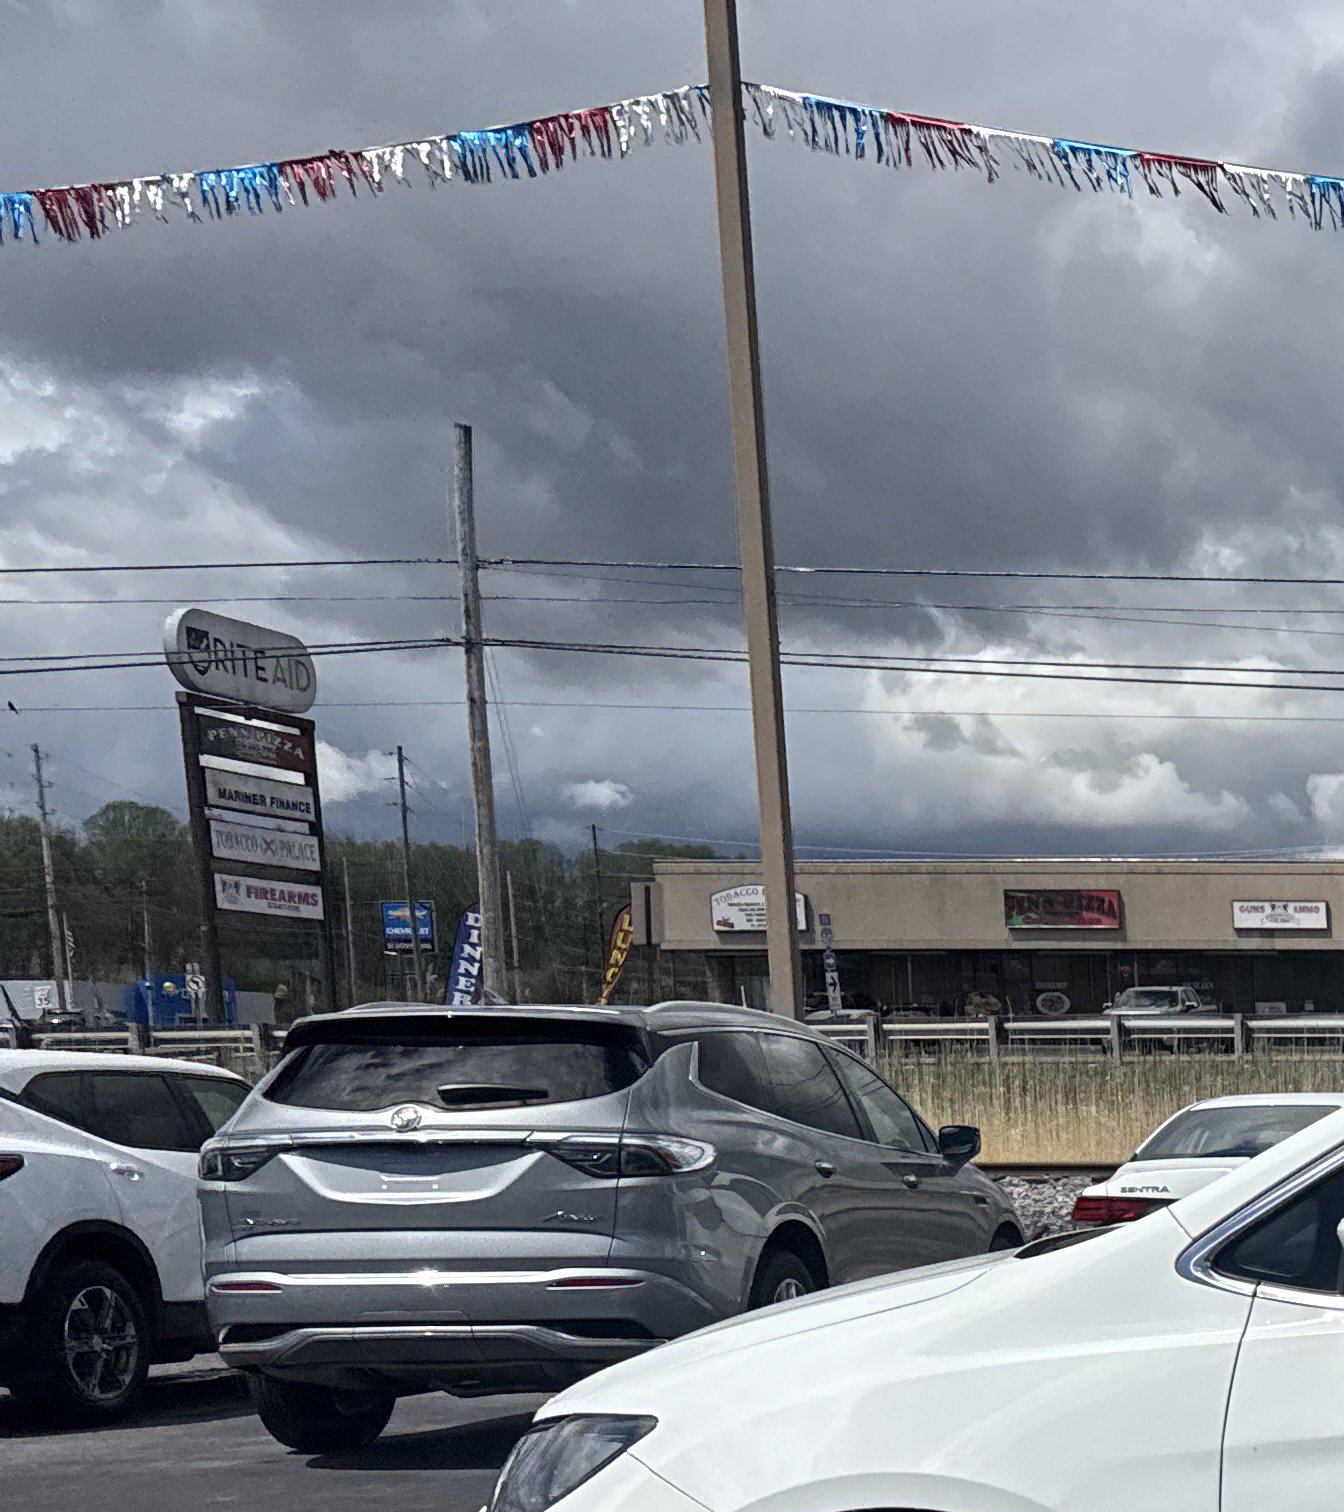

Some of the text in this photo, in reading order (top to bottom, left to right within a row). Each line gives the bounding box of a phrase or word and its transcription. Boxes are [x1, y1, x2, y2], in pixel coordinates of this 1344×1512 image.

[213, 637, 311, 692] RITE AID
[255, 731, 305, 760] PIZZA
[218, 787, 311, 814] MARINER FINANCE
[214, 829, 317, 862] TOBACCO PALACE
[246, 884, 319, 907] FIREARMS
[714, 887, 760, 906] TOBACCO
[451, 911, 483, 1006] DINNER
[37, 996, 51, 1007] 35
[1120, 1185, 1171, 1194] SENTRA
